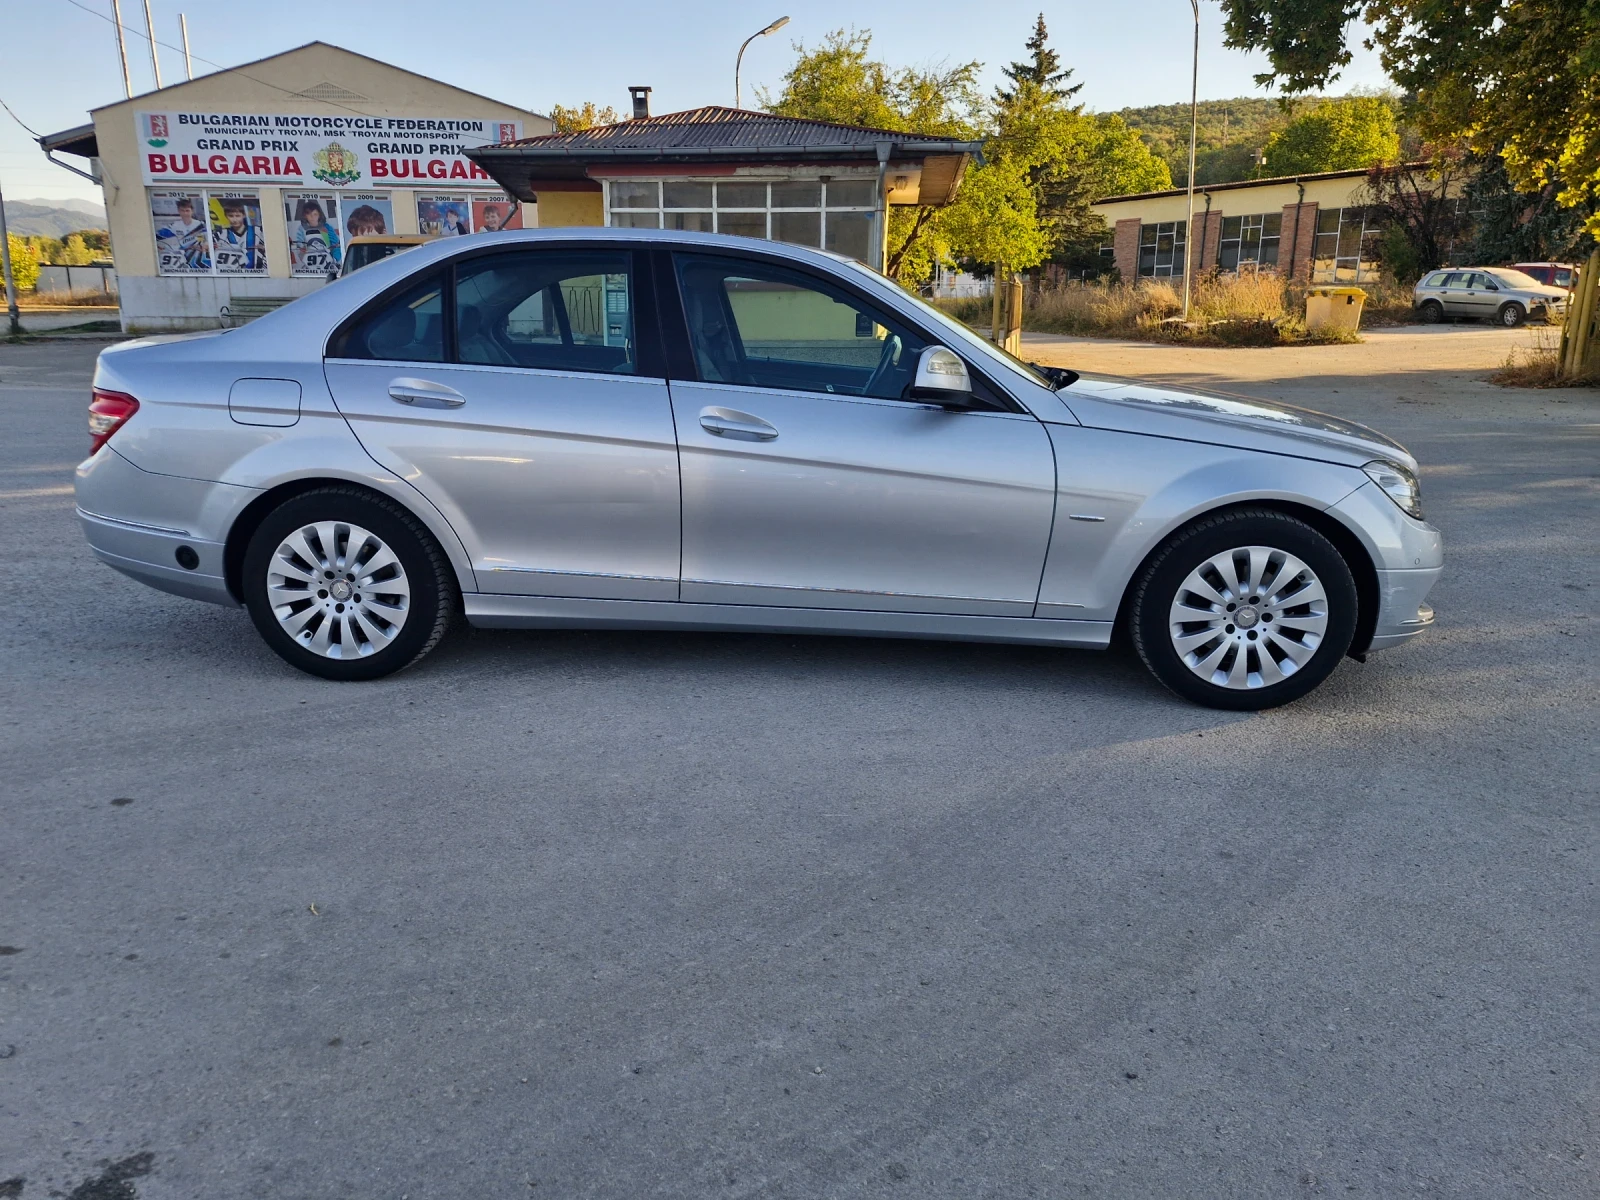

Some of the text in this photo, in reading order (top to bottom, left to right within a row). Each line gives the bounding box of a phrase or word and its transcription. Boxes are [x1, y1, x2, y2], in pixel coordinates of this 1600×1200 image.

[178, 114, 483, 131] BULGARIAN MOTORCYCLE FEDERATION
[204, 127, 275, 136] MUNICIPALITY
[278, 129, 321, 138] TROYAN,
[393, 131, 460, 140] MOTORSPORT
[197, 138, 300, 152] GRAND PRIX
[367, 142, 466, 156] GRAND PRIX
[148, 153, 303, 176] BULGARIA
[370, 158, 493, 180] BULGAR
[162, 255, 181, 265] 97
[217, 253, 242, 265] 97
[307, 254, 327, 266] 97
